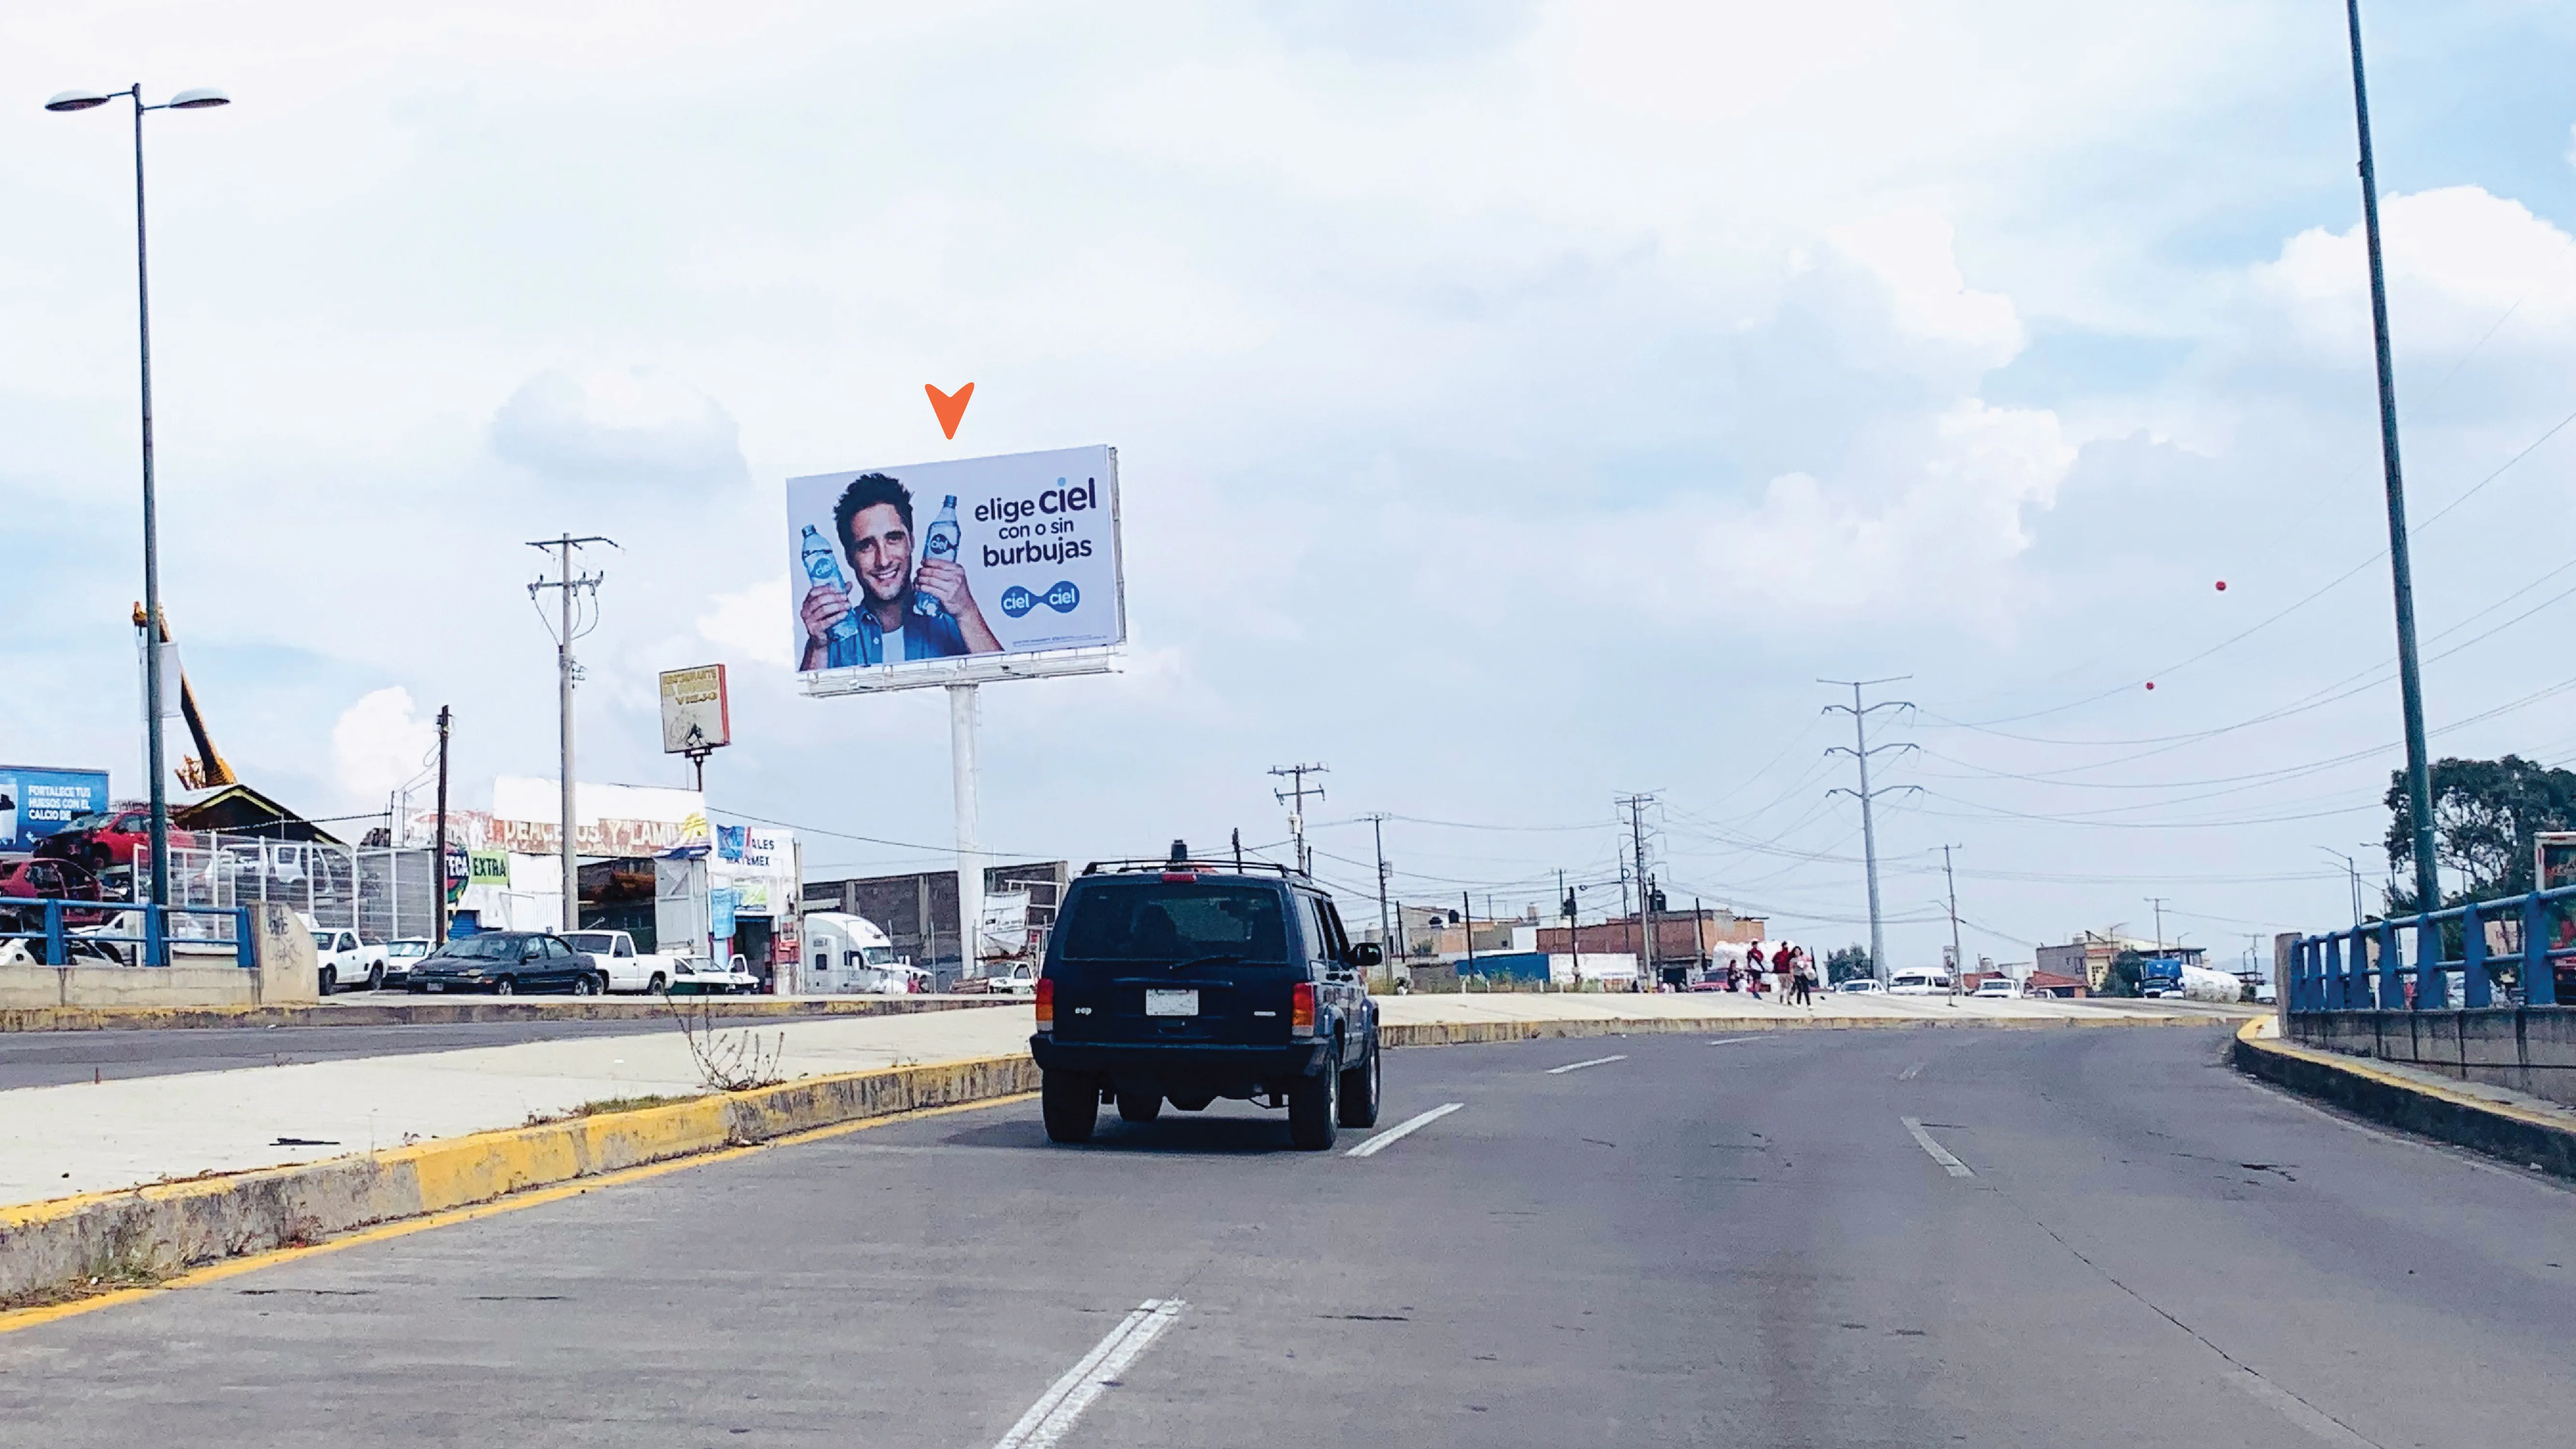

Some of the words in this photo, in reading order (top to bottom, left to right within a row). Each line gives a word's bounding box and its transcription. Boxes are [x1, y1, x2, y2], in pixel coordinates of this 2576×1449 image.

[975, 497, 1035, 523] elige
[1039, 477, 1096, 514] ciel
[999, 525, 1030, 540] con
[1035, 523, 1046, 535] o
[1050, 517, 1074, 534] sin
[983, 537, 1092, 567] burbujas
[1003, 592, 1030, 610] ciel
[1049, 588, 1076, 605] ciel
[28, 785, 74, 796] FORTALECE
[28, 797, 60, 809] HUESOS
[62, 798, 79, 809] CON
[81, 799, 91, 810] EL
[28, 809, 58, 820] CALCIO
[59, 810, 71, 821] DE
[607, 820, 622, 844] Y
[473, 858, 506, 877] EXTRA
